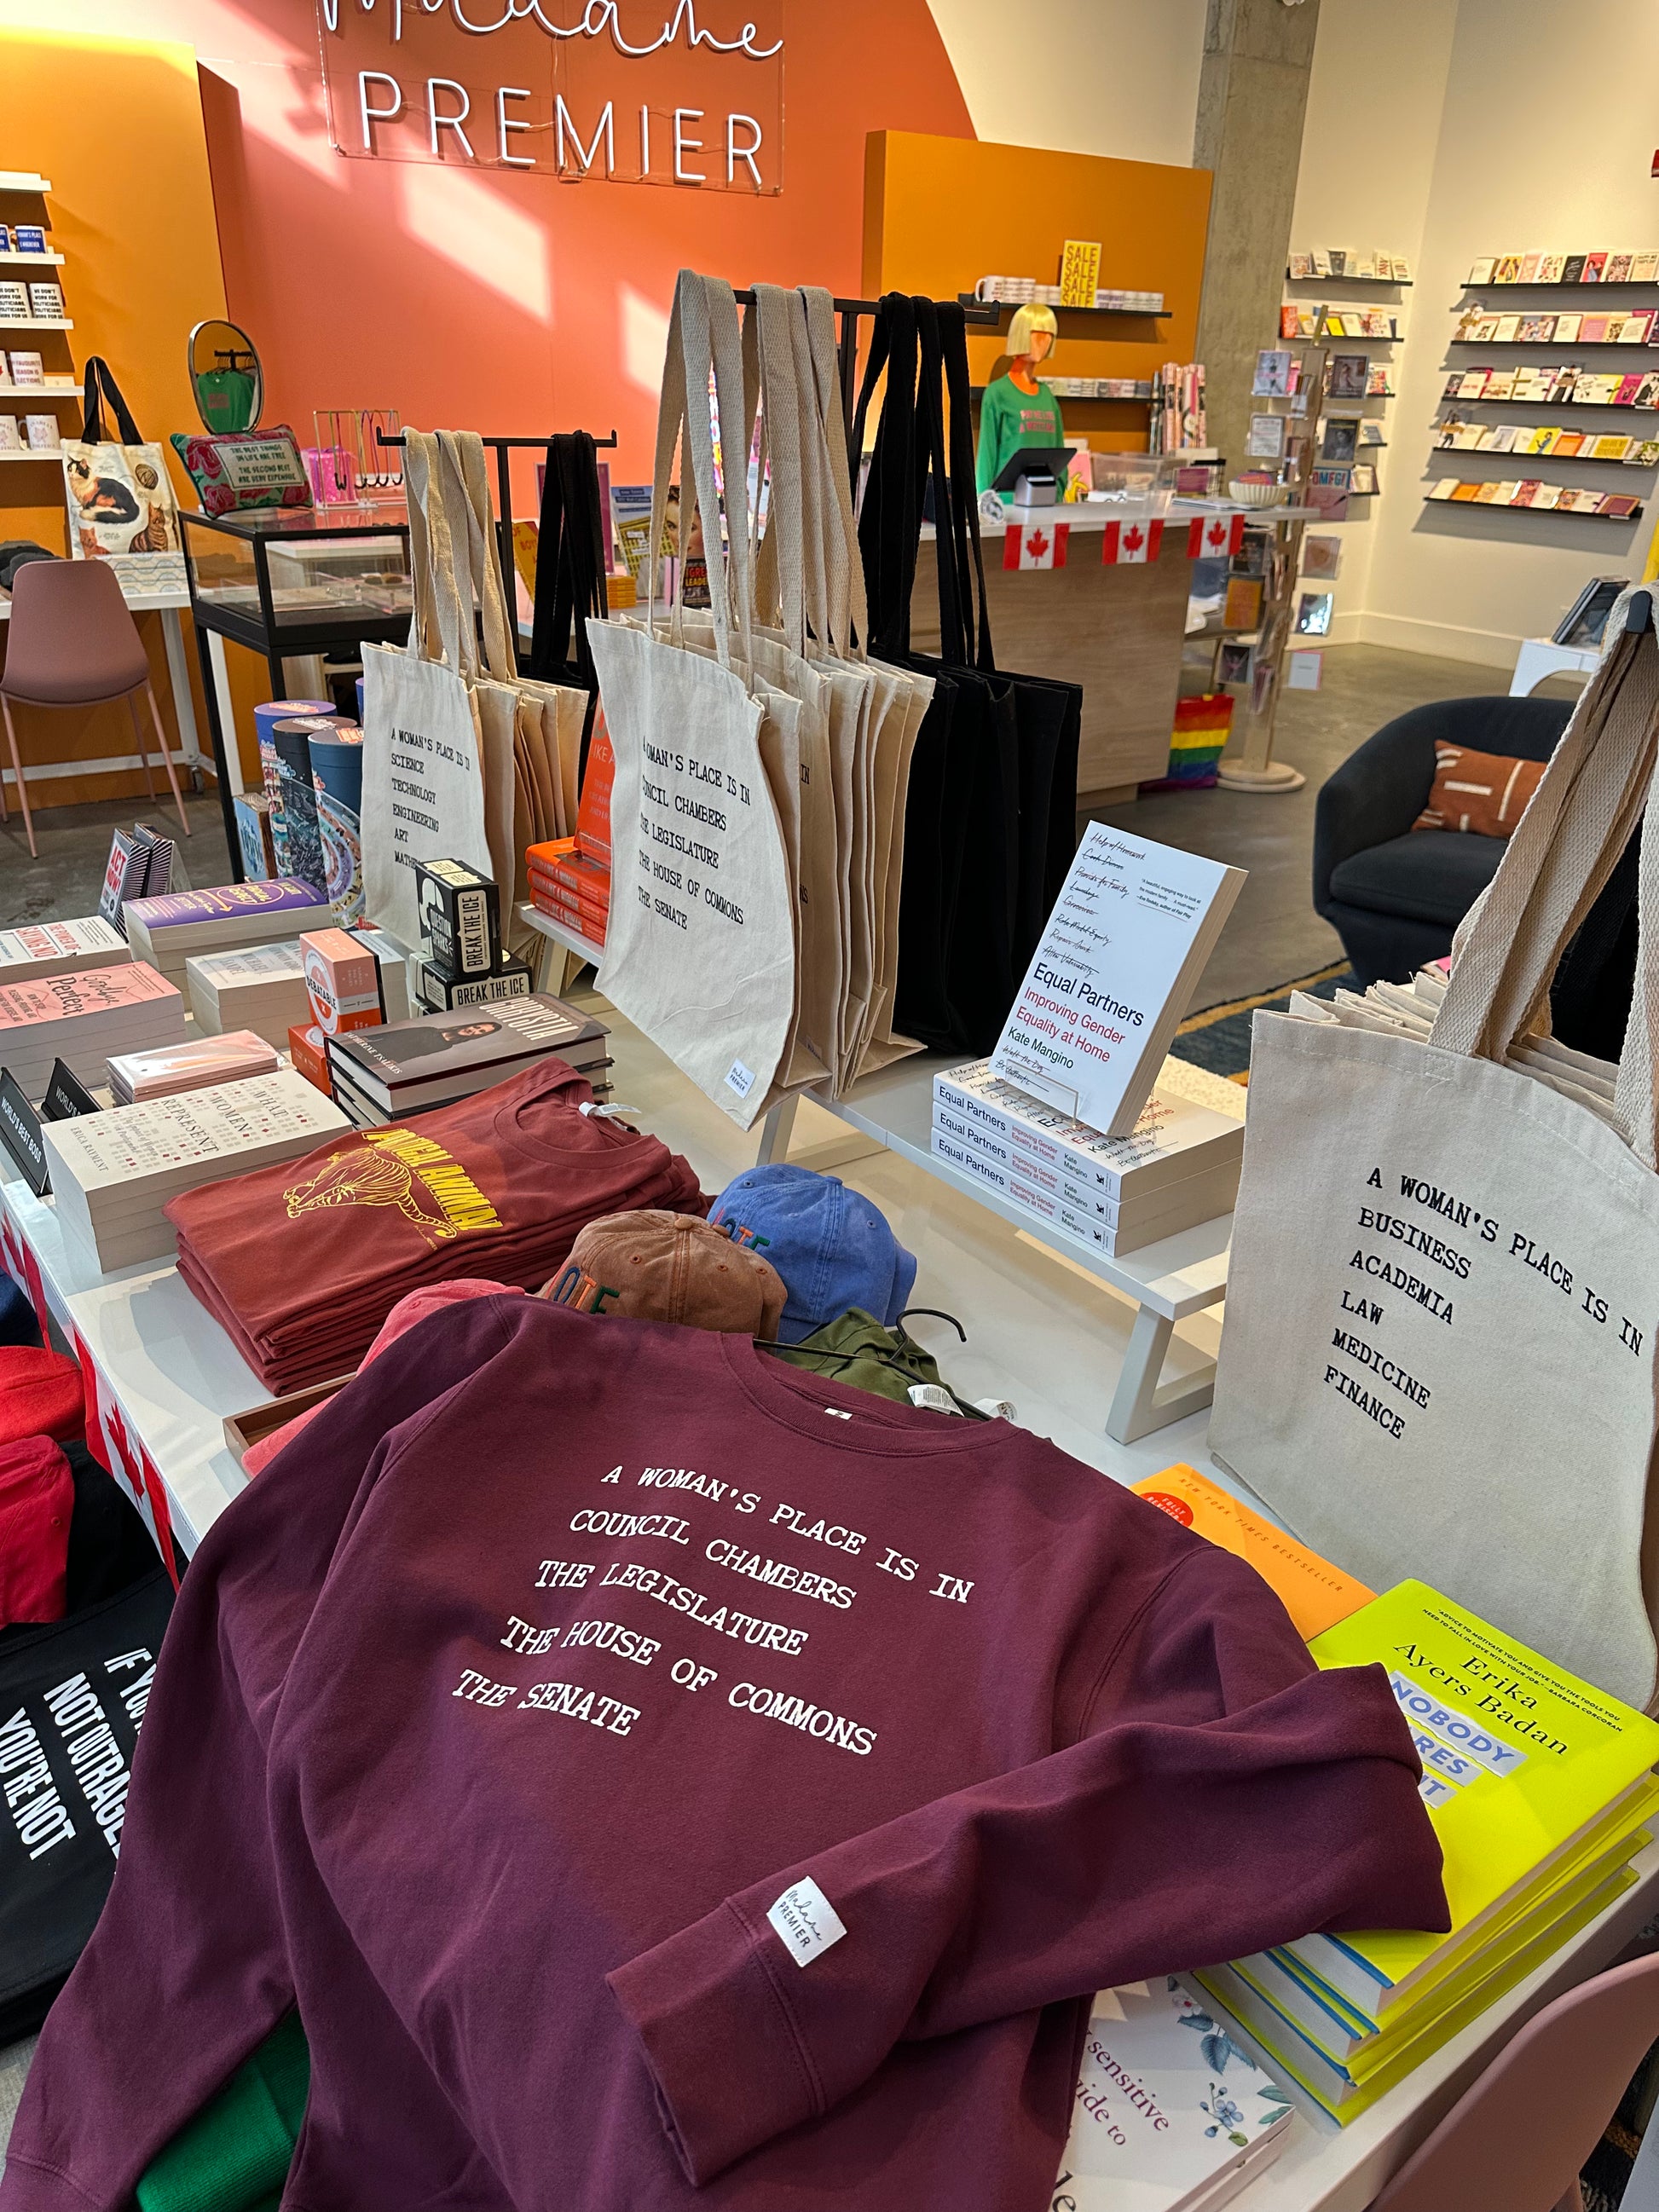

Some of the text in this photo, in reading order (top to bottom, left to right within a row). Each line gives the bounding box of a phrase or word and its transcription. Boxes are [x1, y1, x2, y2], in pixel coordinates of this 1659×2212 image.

[358, 70, 764, 186] PREMIER
[1065, 262, 1096, 280] SALE
[1066, 245, 1098, 263] SALE
[1063, 278, 1095, 296] SALE
[1313, 471, 1346, 487] OMFG!
[390, 728, 464, 766] A WOMAN'S PLACE IS
[390, 754, 425, 775] SCIENCE
[391, 778, 436, 805] TECHNOLOGY
[689, 759, 722, 788] PLACE
[727, 775, 737, 796] IS
[741, 783, 751, 806] IN
[392, 804, 439, 833] ENGINEERING
[394, 828, 409, 843] ART
[675, 795, 726, 831] CHAMBERS
[110, 846, 126, 873] ACT
[652, 823, 719, 869] LEGISLATURE
[106, 867, 122, 895] NOW!
[639, 849, 743, 925] THE HOUSE OF COMMONS
[639, 886, 687, 930] THE SENATE
[15, 927, 58, 957] SAYING NO
[55, 929, 76, 944] POWER
[462, 896, 483, 967] BREAK THE ICE
[46, 976, 90, 1016] Perfect
[306, 975, 338, 1010] DEBATABLE
[457, 985, 488, 1005] BREAK
[490, 981, 507, 999] THE
[510, 977, 524, 996] ICE
[1033, 962, 1144, 1026] Equal Partners
[478, 996, 579, 1041] CHRYSTIA
[1016, 1006, 1111, 1062] Equality at Home
[1024, 986, 1125, 1045] Improving Gender
[1008, 1026, 1074, 1069] Kate Mangino
[55, 1086, 78, 1117] WORLD'S
[209, 1095, 253, 1134] WOMEN
[255, 1090, 289, 1119] WHAT
[939, 1086, 1006, 1131] Equal Partners
[1, 1095, 43, 1164] WORLD'S BEST BOSS
[161, 1097, 220, 1153] REPRESENT
[70, 1127, 109, 1172] ERICA RAYMENT
[413, 1164, 504, 1231] ANIMAL
[1358, 1207, 1472, 1279] BUSINESS
[1367, 1167, 1644, 1356] A WOMAN'S PLACE IS IN
[1340, 1290, 1384, 1325] LAW
[1350, 1250, 1454, 1325] ACADEMIA
[1332, 1327, 1431, 1409] MEDICINE
[1323, 1365, 1406, 1439] FINANCE
[1161, 1498, 1186, 1516] FULLY
[601, 1465, 975, 1603] A WOMAN'S PLACE IS IN
[1178, 1478, 1344, 1592] NEW YORK TIMES BESTSELLER
[569, 1509, 858, 1610] COUNCIL CHAMBERS
[535, 1559, 809, 1656] THE LEGISLATURE
[104, 1648, 153, 1673] IF
[1422, 1608, 1440, 1622] NEED
[1440, 1619, 1449, 1629] TO
[1448, 1625, 1464, 1638] FALL
[1471, 1639, 1489, 1654] LOVE
[1488, 1650, 1506, 1665] WITH
[1506, 1662, 1528, 1678] YOUR
[1581, 1706, 1623, 1733] CORCORAN
[1460, 1655, 1539, 1711] Erika
[1463, 1623, 1472, 1633] TO
[1471, 1628, 1504, 1654] MOTIVATE
[1503, 1650, 1518, 1663] YOU
[1517, 1660, 1534, 1672] AND
[1534, 1669, 1550, 1682] GIVE
[1549, 1678, 1566, 1691] YOU
[1566, 1688, 1581, 1701] THE
[1580, 1695, 1604, 1714] TOOLS
[1603, 1709, 1621, 1721] YOU
[43, 1672, 106, 1737] NOT
[451, 1668, 642, 1737] THE SENATE
[500, 1615, 878, 1758] THE HOUSE OF COMMONS
[1394, 1643, 1569, 1756] Ayers Badan
[1391, 1680, 1514, 1762] NOBODY
[0, 1707, 77, 1861] YOU'RE NOT
[778, 1901, 811, 1948] PREMIER
[1087, 2041, 1170, 2131] sensitive
[1107, 2125, 1126, 2146] to
